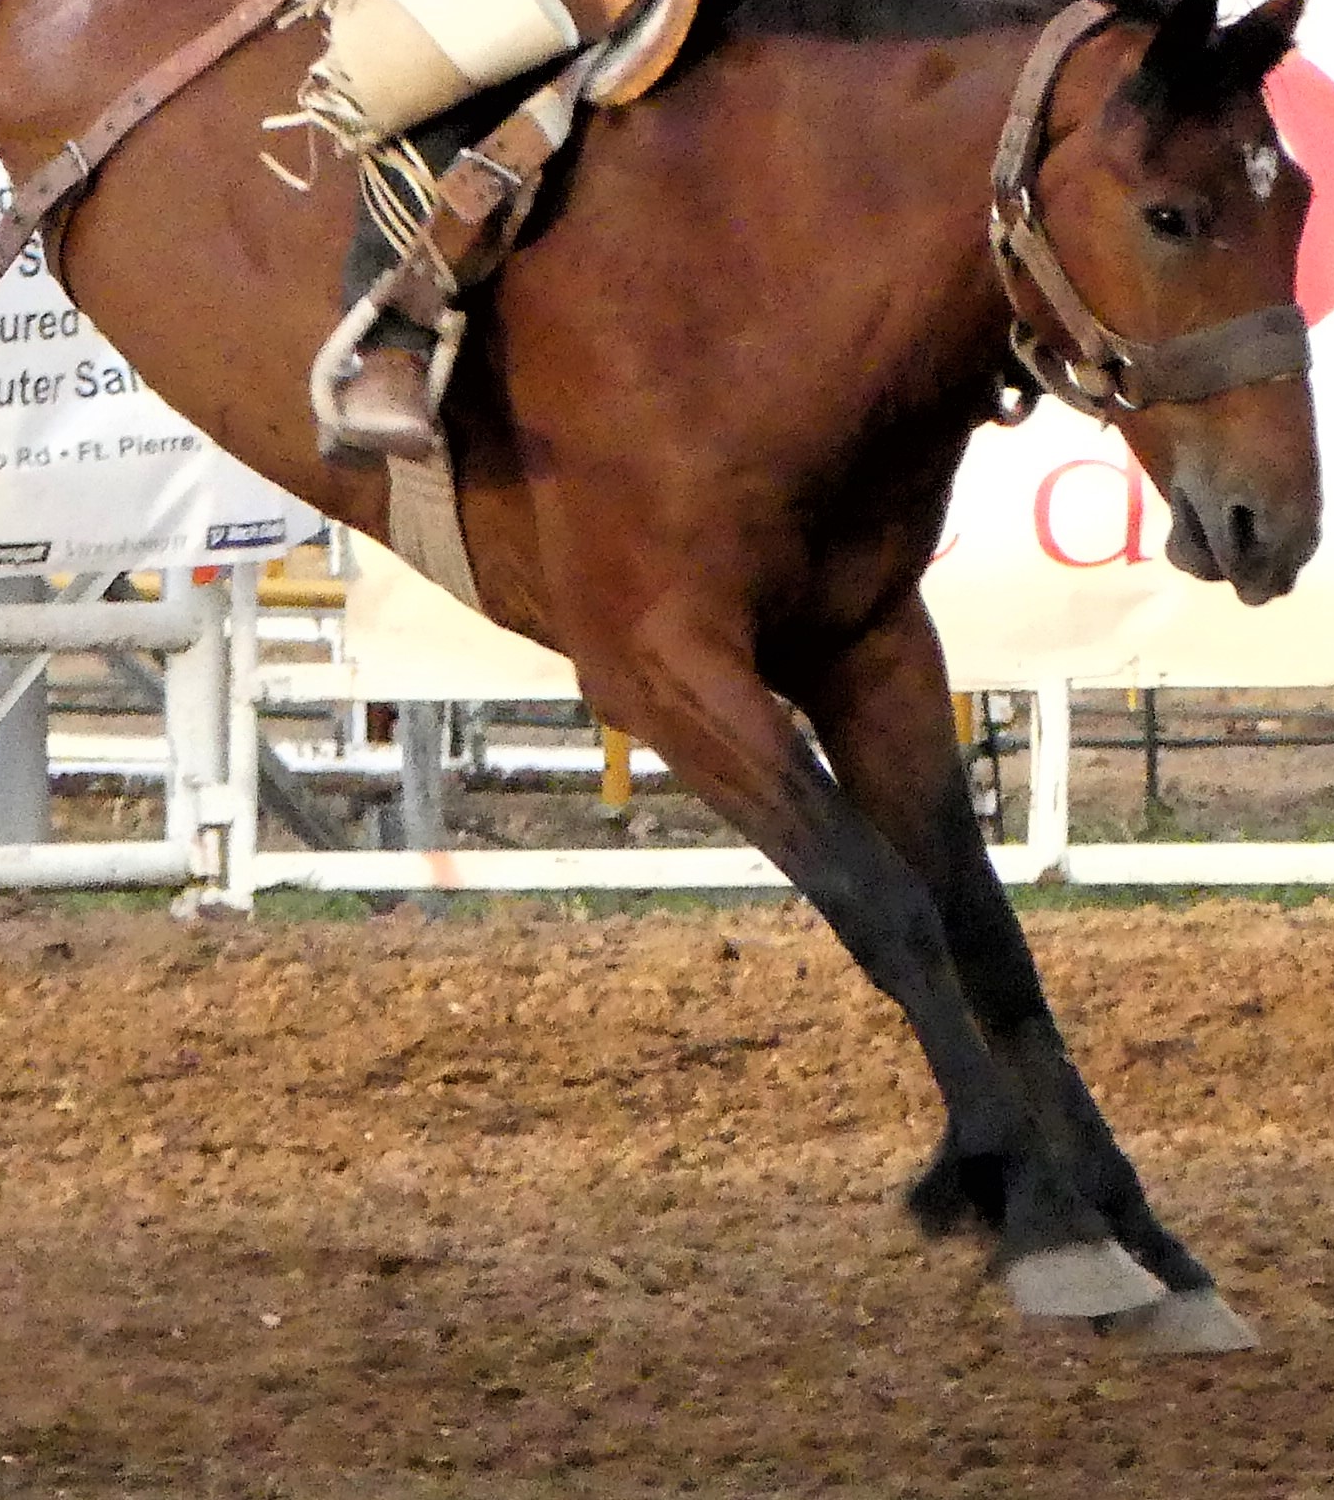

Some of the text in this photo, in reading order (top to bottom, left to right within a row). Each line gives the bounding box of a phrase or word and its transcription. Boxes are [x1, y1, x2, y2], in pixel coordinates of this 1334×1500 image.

[18, 236, 43, 278] S
[75, 359, 140, 400] Sal
[15, 445, 51, 468] Rd
